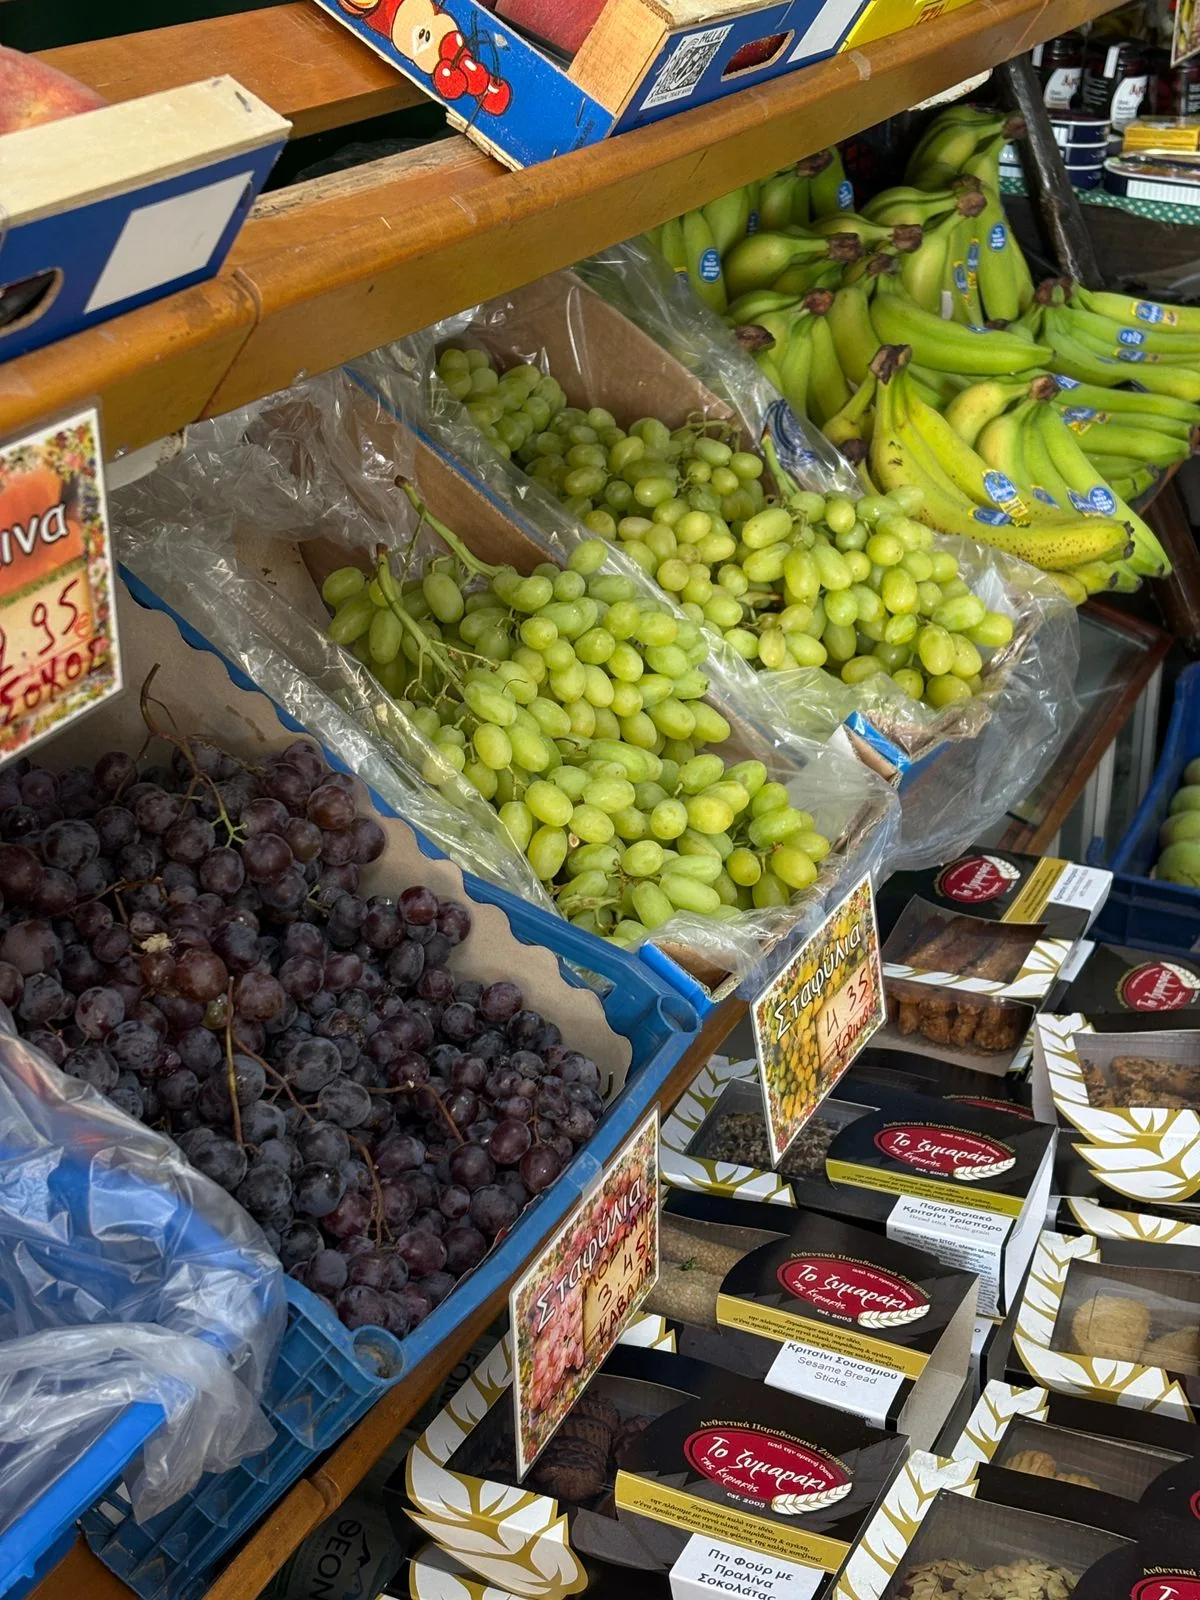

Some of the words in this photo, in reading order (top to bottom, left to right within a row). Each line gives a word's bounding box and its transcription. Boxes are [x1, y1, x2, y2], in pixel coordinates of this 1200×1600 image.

[774, 922, 862, 1041] Σταφύλια
[893, 1132, 911, 1147] Το
[912, 1138, 995, 1165] ζυμαράκι
[902, 1205, 946, 1221] Κριτσίνι
[949, 1215, 1003, 1232] Τρίσπορο
[920, 1202, 993, 1223] Παραδοσιακό
[535, 1177, 642, 1334] Σταφύλια
[798, 1264, 818, 1281] Το
[817, 1274, 907, 1310] ζυμαράκι
[817, 1308, 830, 1317] est.
[831, 1312, 852, 1323] 2005
[787, 1341, 833, 1362] Κριτσίνι
[834, 1355, 899, 1381] Σουσαμιού
[797, 1356, 842, 1375] Sesame
[844, 1369, 878, 1386] Bread
[814, 1370, 849, 1388] Sticks.
[700, 1419, 750, 1428] Αυθεντικά
[752, 1422, 817, 1450] Παραδοσιακά
[707, 1436, 730, 1458] Το
[728, 1449, 827, 1492] ζυμαράκι
[726, 1491, 741, 1501] est.
[744, 1497, 766, 1509] 2005
[708, 1548, 731, 1562] Πτι
[734, 1556, 773, 1576] Φούρ
[775, 1570, 795, 1582] με
[713, 1563, 774, 1589] Πραλίνα
[1143, 1566, 1197, 1577] Αυθεντικά
[697, 1572, 777, 1600] Σοκολάτας
